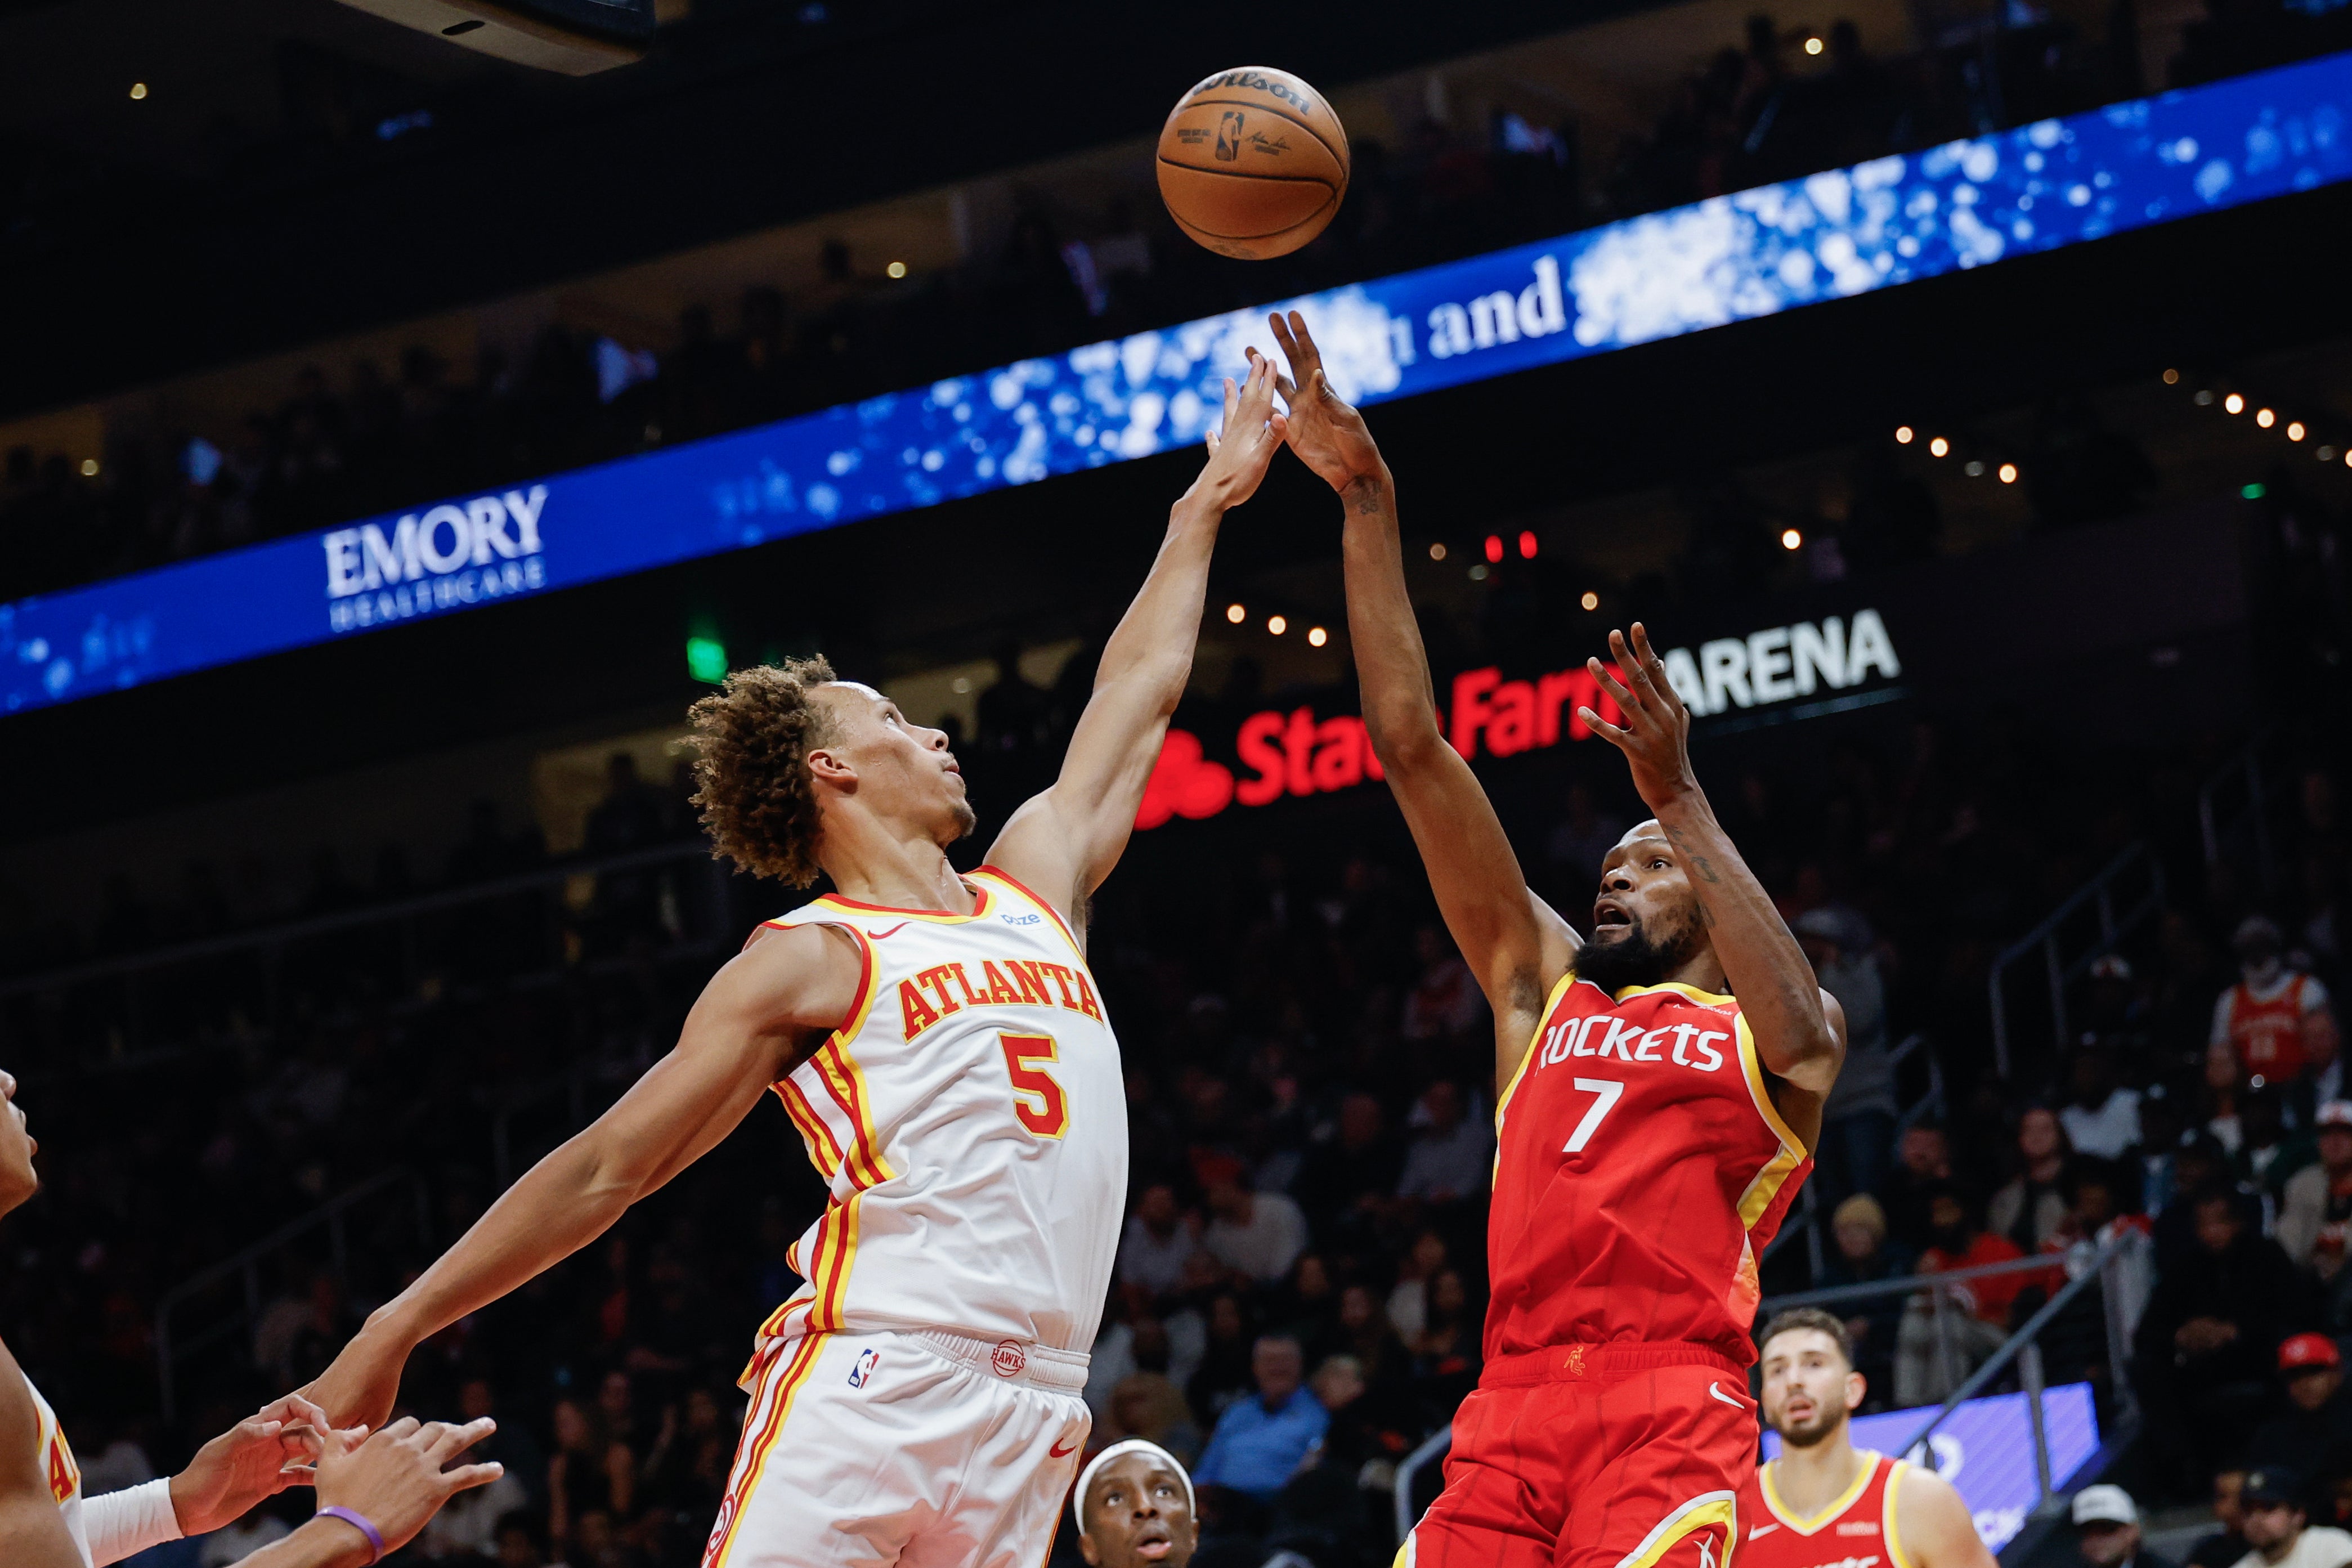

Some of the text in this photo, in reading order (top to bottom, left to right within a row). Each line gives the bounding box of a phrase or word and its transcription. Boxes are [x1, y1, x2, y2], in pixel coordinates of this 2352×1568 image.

[1427, 254, 1567, 359] and
[322, 484, 549, 598] EMORY
[1235, 704, 1445, 807] Sta
[1664, 607, 1902, 718] ARENA
[896, 958, 1106, 1045] ATLANTA
[997, 1031, 1070, 1141] 5
[1562, 1077, 1624, 1153] 7
[991, 1347, 1026, 1369] HAWKS
